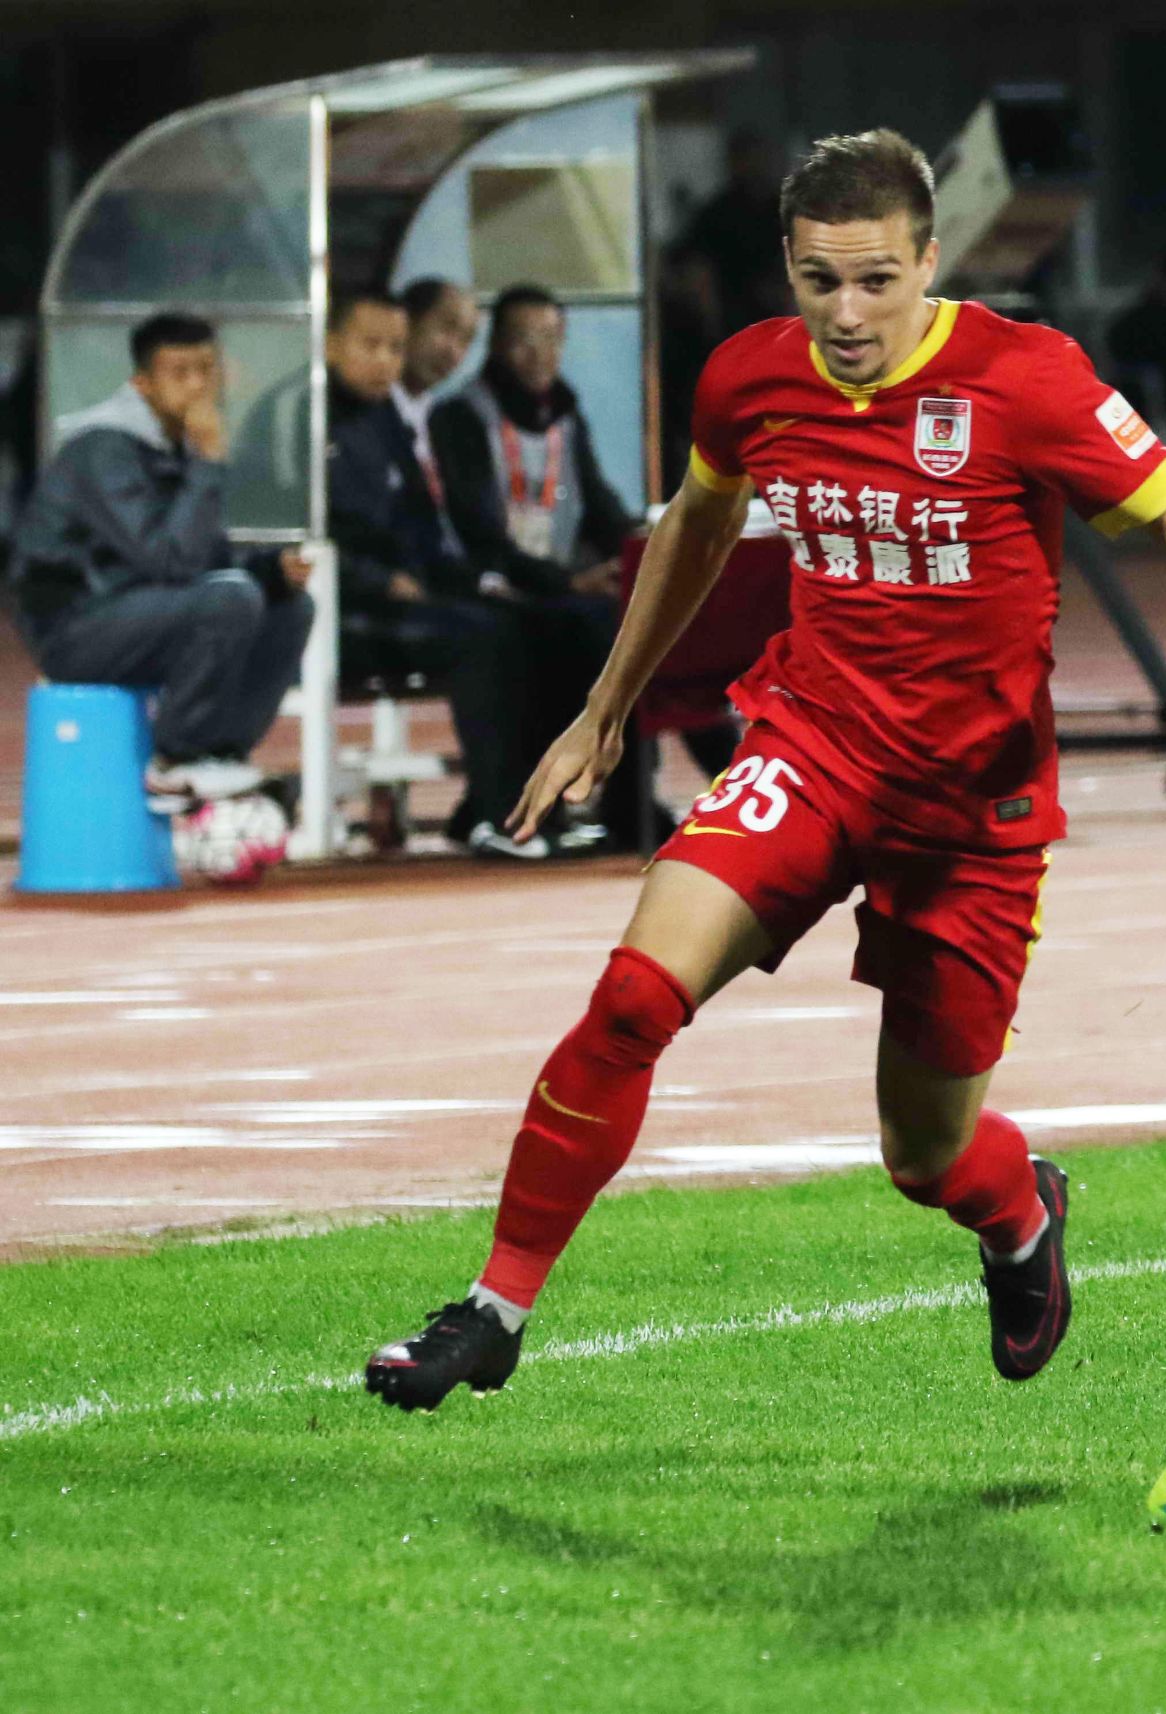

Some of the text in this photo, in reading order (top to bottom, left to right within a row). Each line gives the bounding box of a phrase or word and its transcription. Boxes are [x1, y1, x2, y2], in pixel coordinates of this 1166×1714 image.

[766, 475, 969, 541] 吉林银行
[698, 755, 804, 832] 35
